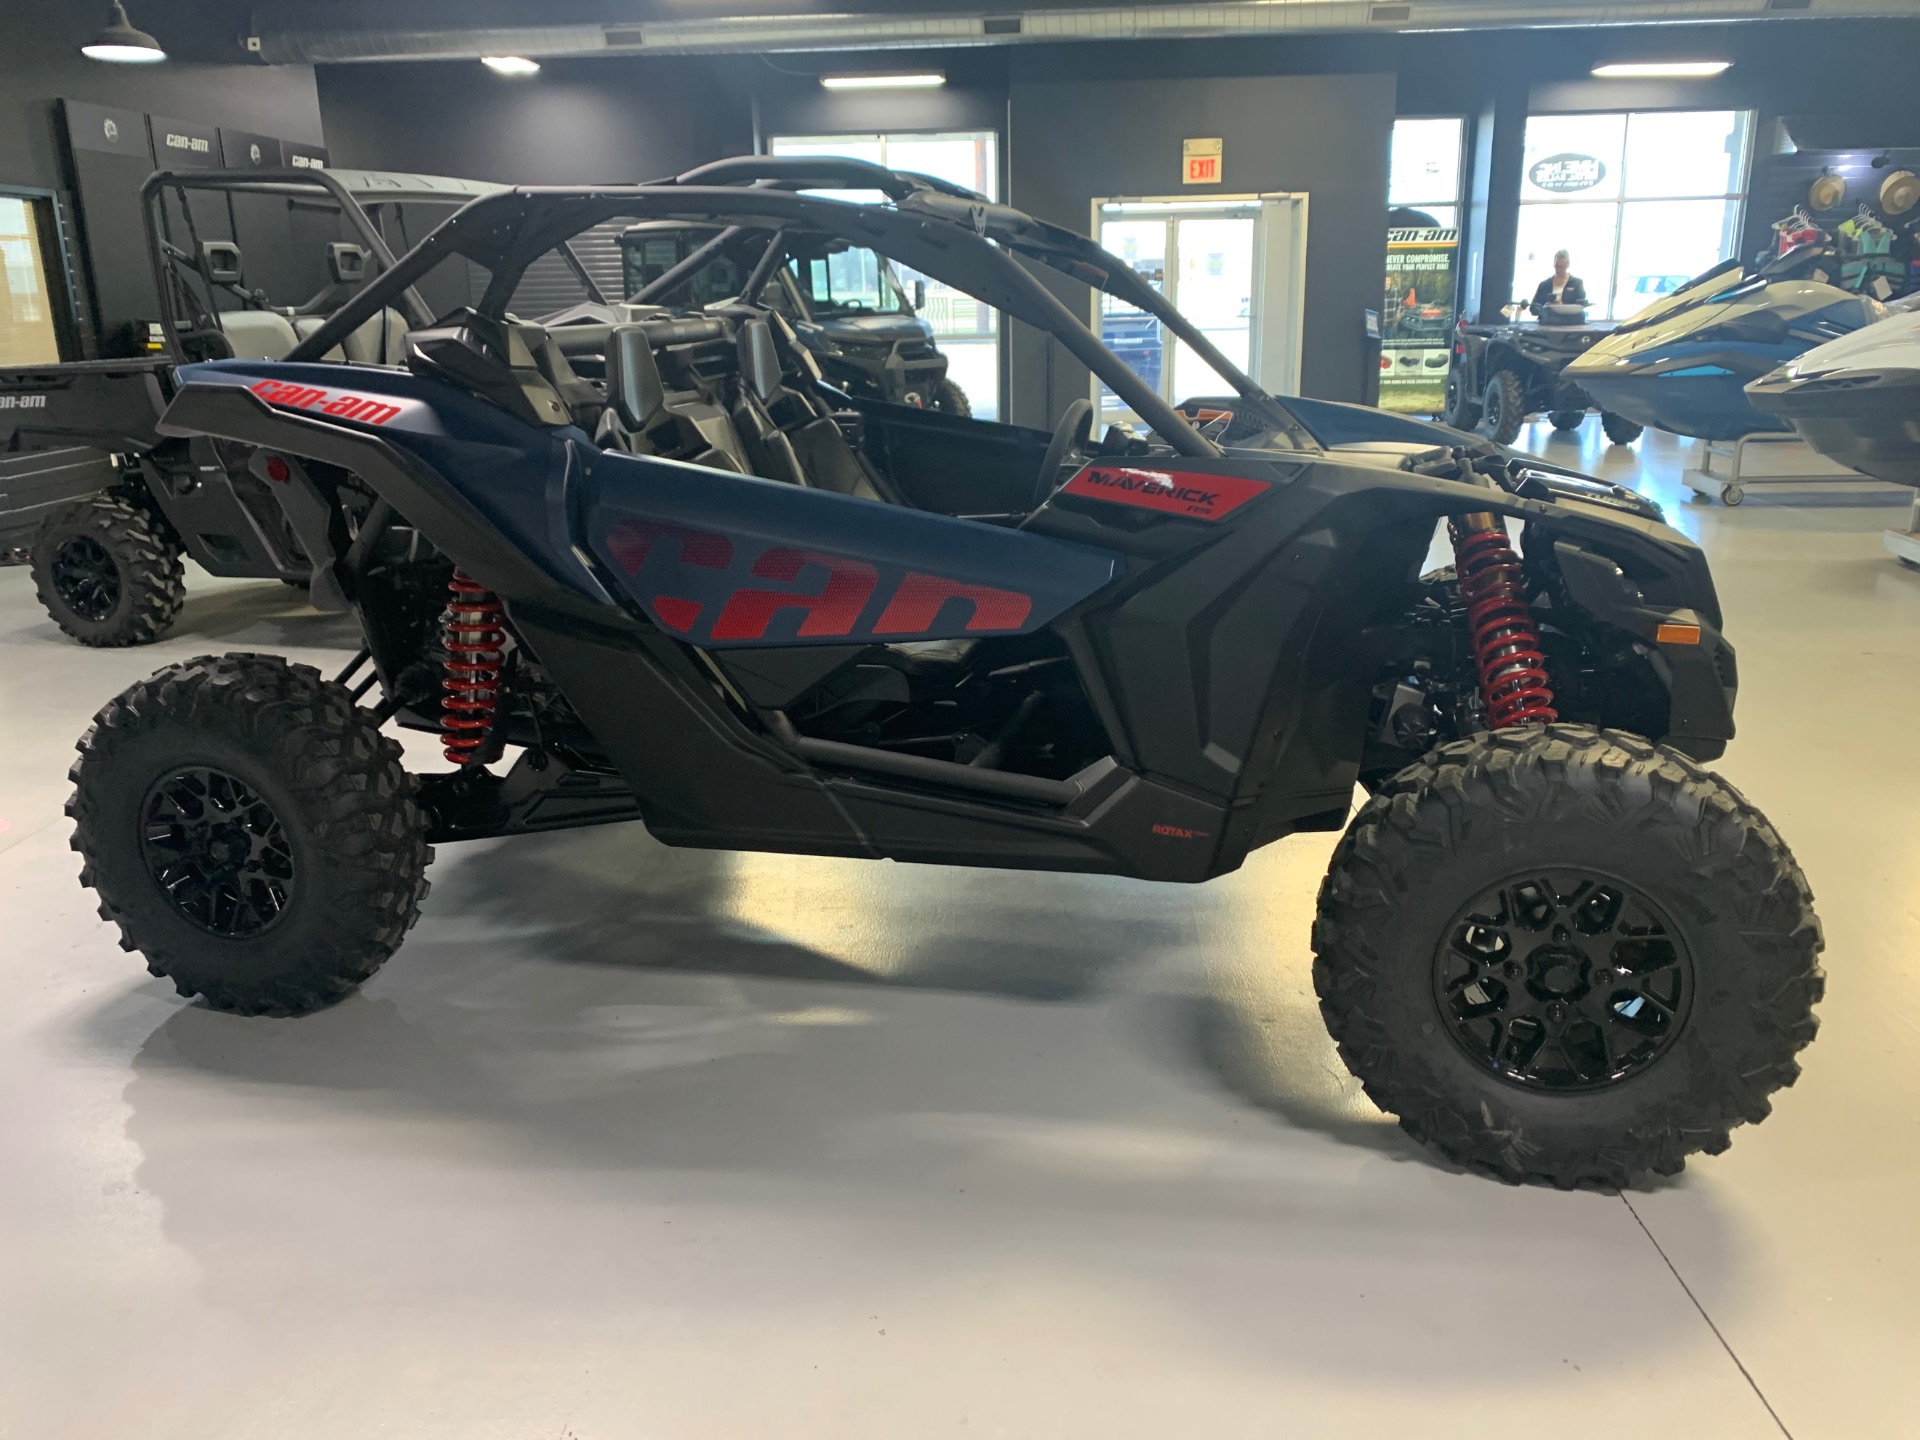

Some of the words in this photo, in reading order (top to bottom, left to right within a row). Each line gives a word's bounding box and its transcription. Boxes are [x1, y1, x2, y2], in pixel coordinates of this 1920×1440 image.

[166, 133, 209, 152] can-am
[292, 155, 324, 169] can-am
[1190, 159, 1216, 179] EXIT
[0, 395, 46, 408] an-am
[251, 379, 402, 426] can-am
[1087, 470, 1220, 506] MAVERICK
[1152, 824, 1193, 839] ROTAX
